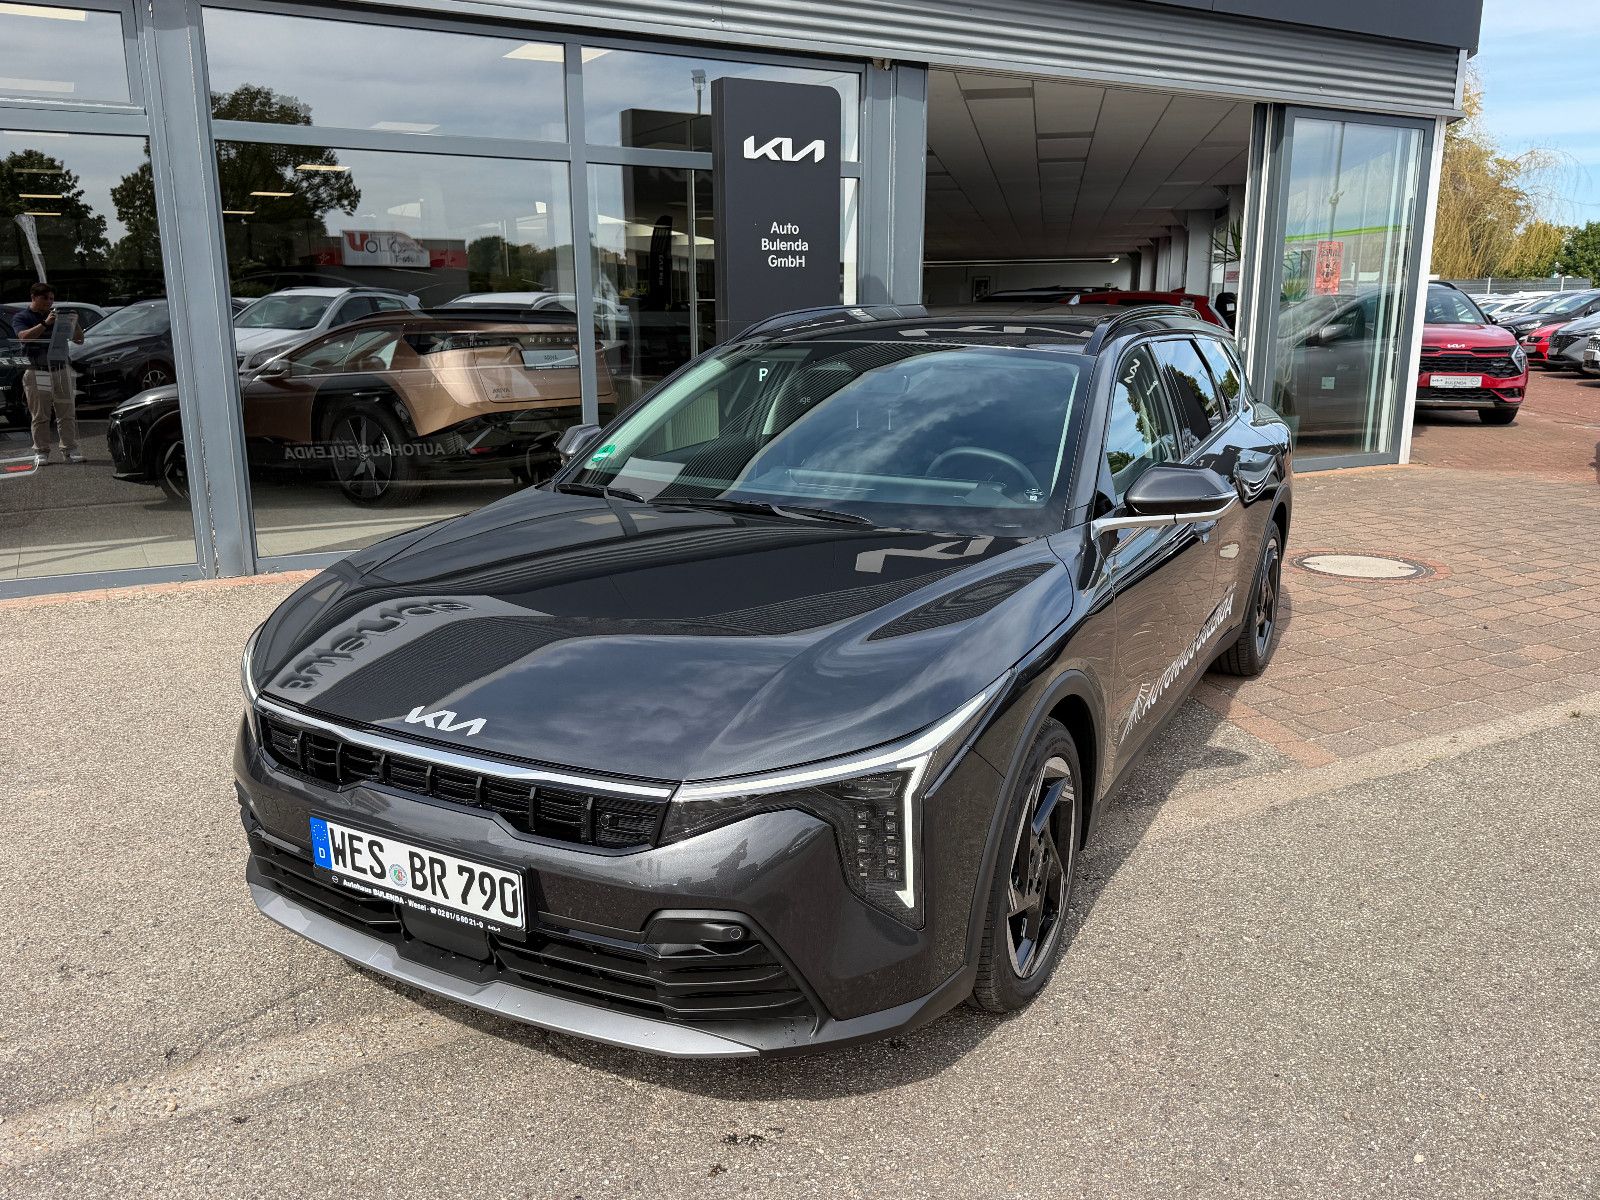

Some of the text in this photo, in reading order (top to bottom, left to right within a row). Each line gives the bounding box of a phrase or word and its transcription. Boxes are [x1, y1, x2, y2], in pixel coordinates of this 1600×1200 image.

[743, 135, 825, 163] KIA
[770, 221, 800, 235] Auto
[761, 238, 809, 251] Bulenda
[767, 254, 806, 268] GmbH
[404, 705, 488, 737] KIA
[318, 847, 326, 859] D
[329, 827, 519, 919] WES BR 790
[342, 879, 373, 894] Autohaus
[372, 888, 405, 905] BULENDA
[407, 899, 427, 912] Wesel
